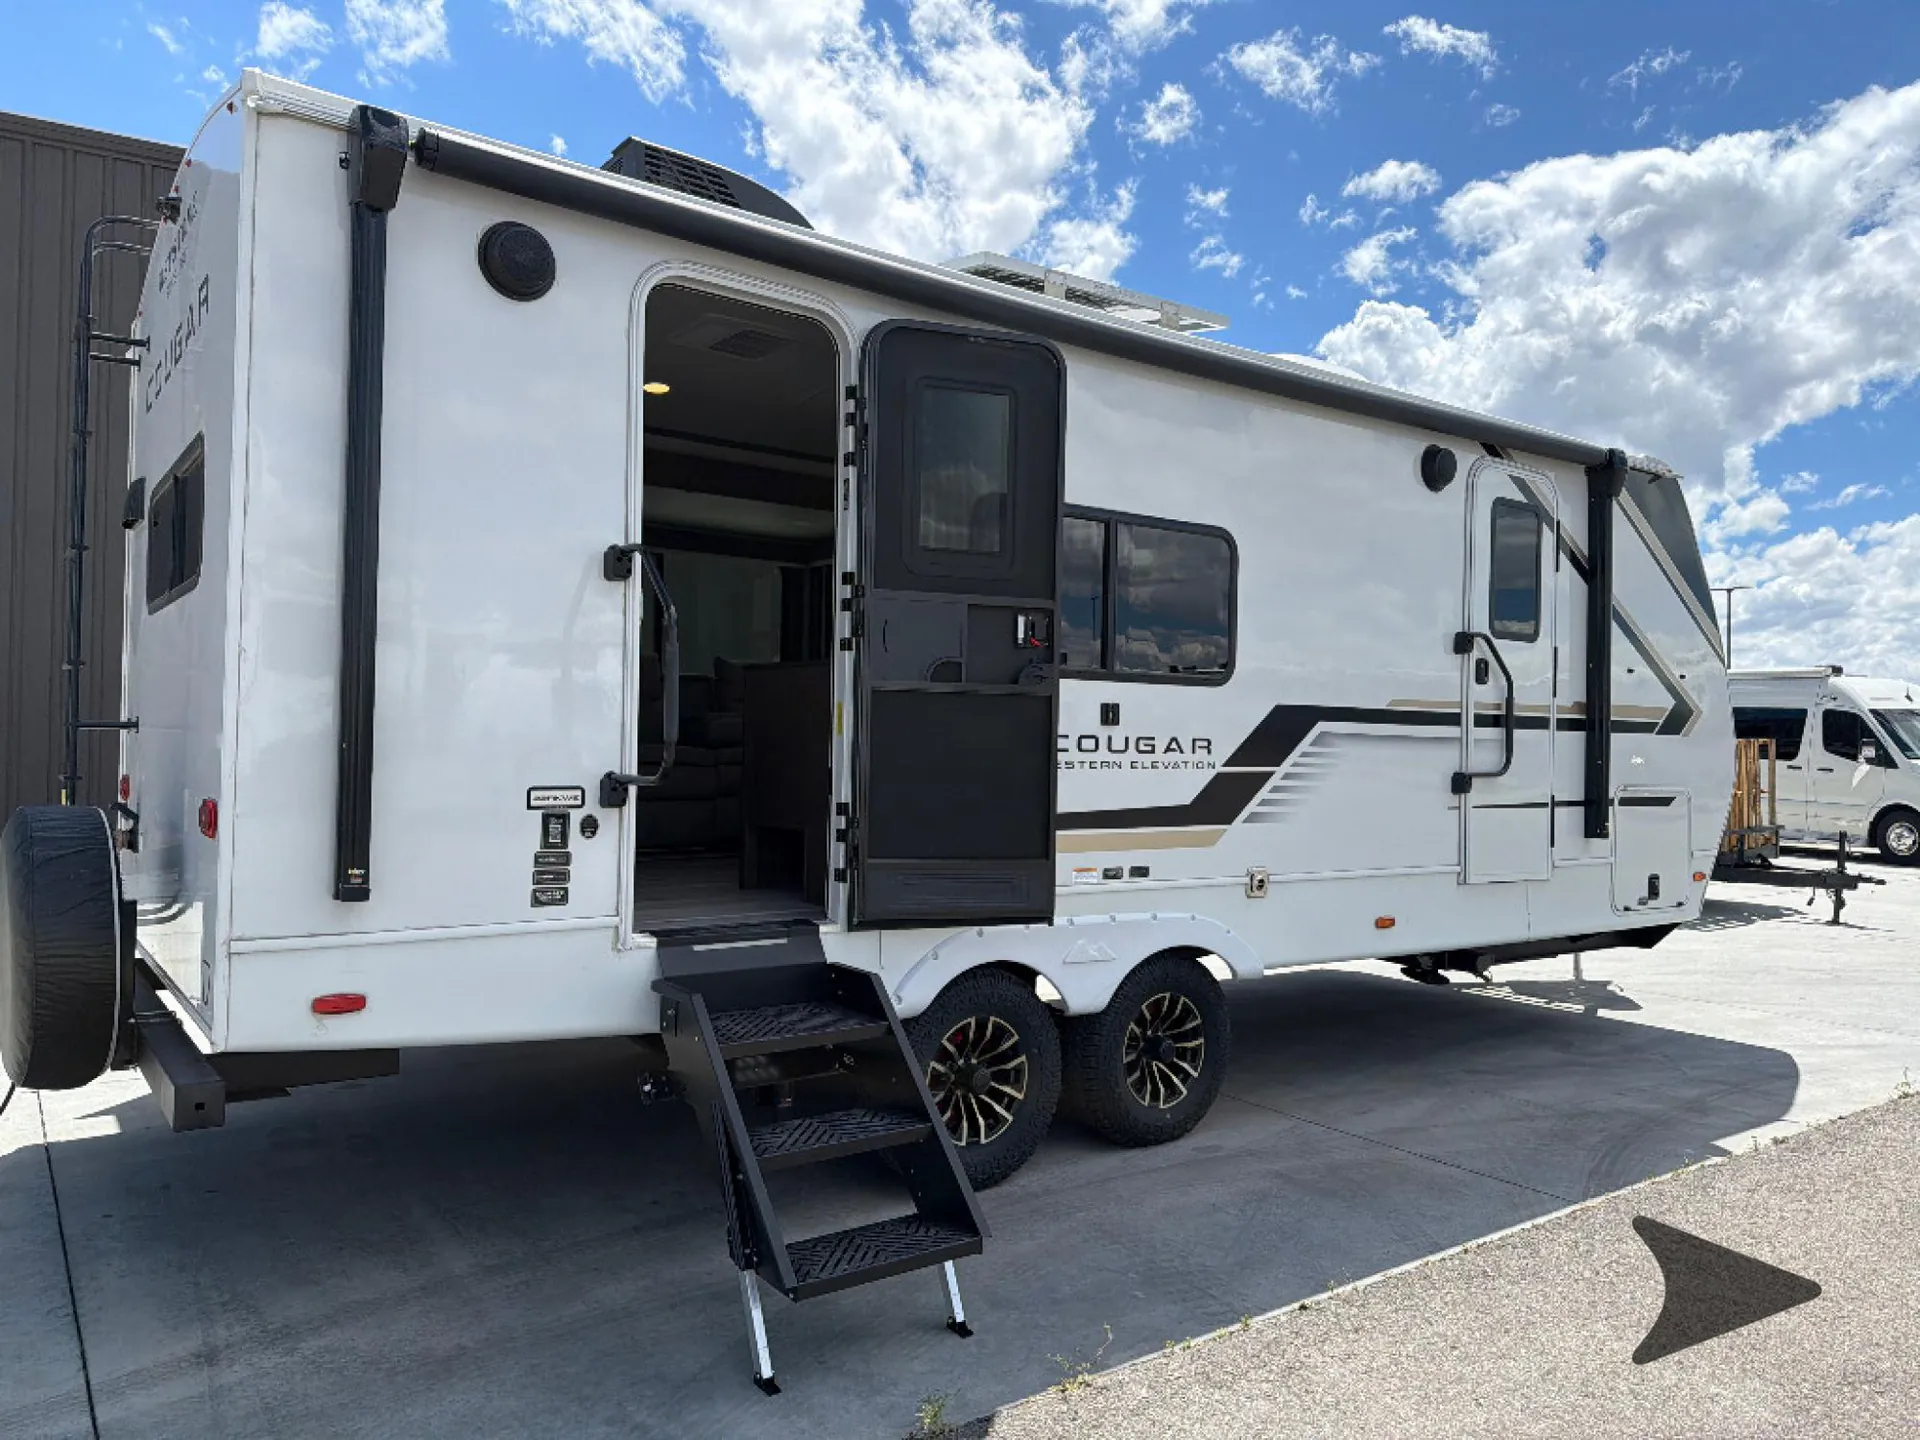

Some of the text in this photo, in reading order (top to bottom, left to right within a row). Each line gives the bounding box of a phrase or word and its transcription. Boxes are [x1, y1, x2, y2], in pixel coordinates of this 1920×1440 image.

[146, 272, 209, 414] COUGAR
[1057, 760, 1216, 770] ESTERN ELEVATION
